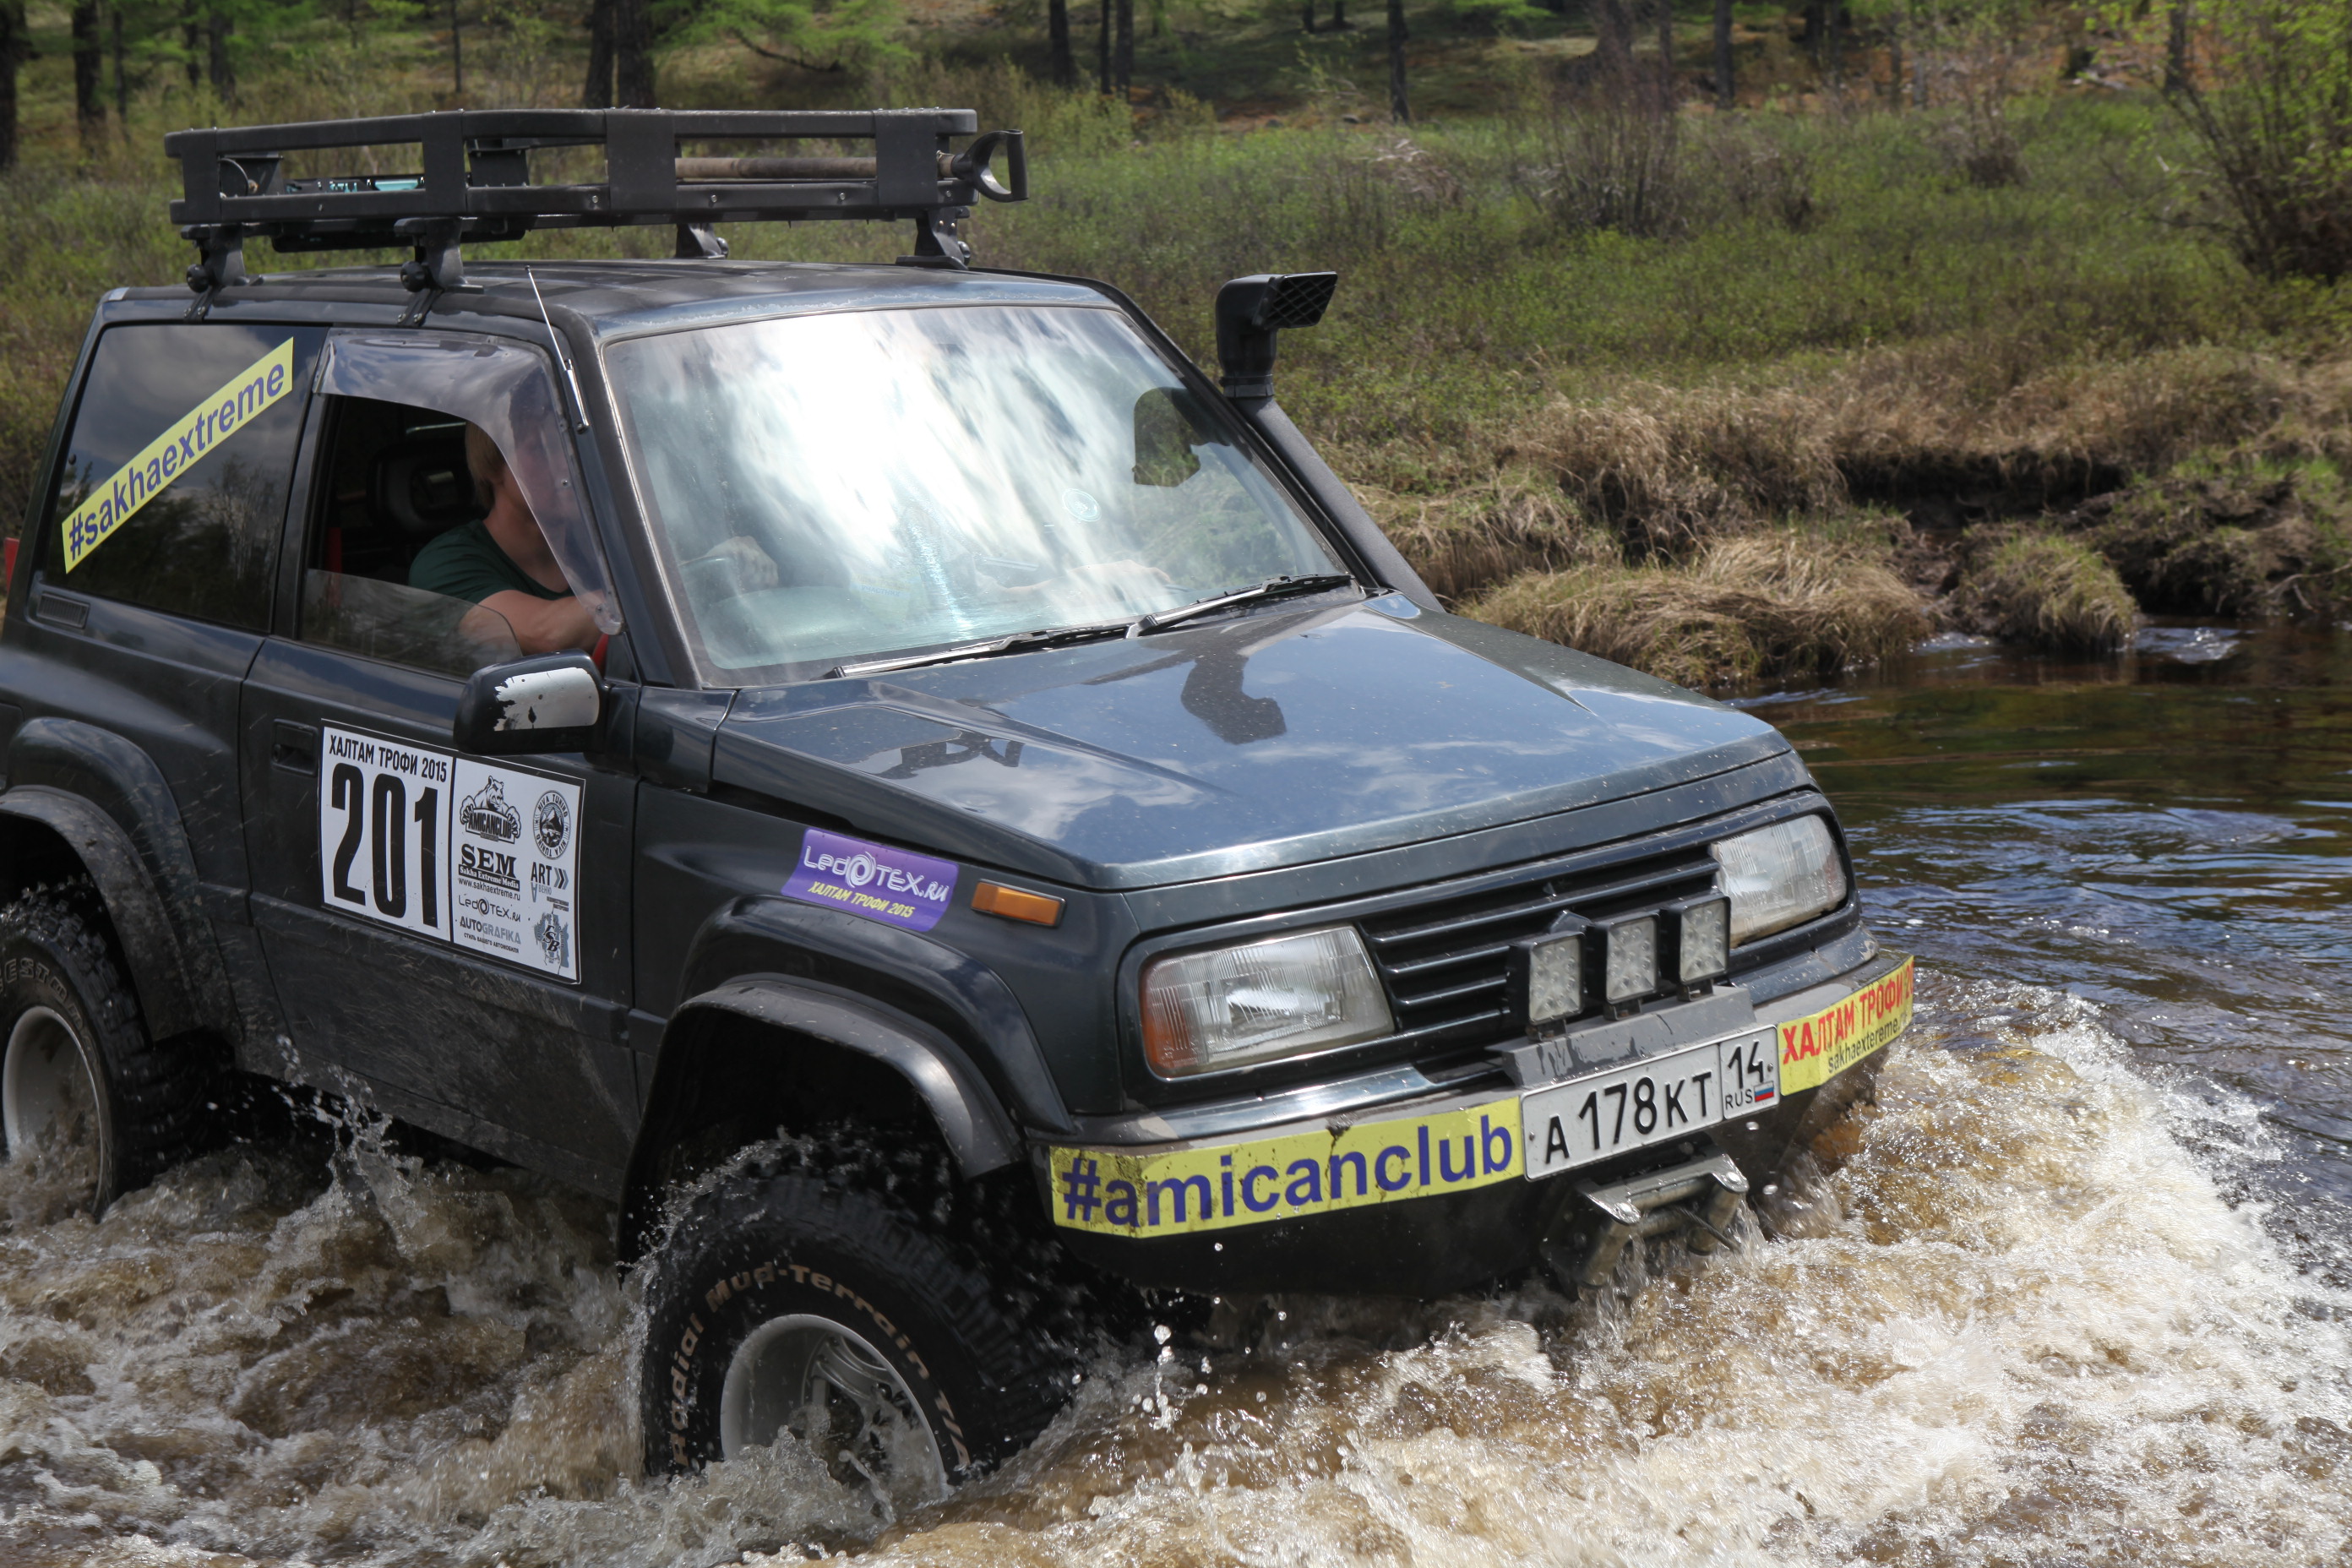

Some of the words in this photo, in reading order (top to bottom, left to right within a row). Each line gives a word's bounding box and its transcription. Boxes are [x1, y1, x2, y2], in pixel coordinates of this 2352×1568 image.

[69, 363, 285, 561] #sakhaextreme
[329, 734, 374, 765] ХАЛТАМ
[378, 746, 417, 776] ТРОФИ
[422, 757, 447, 782] 2015
[331, 762, 440, 929] 201
[461, 843, 517, 879] SEM
[458, 877, 520, 901] www.sakhaextreme.ru
[460, 866, 477, 878] Sakha
[477, 870, 502, 885] Extreme
[502, 878, 519, 888] Media
[531, 862, 552, 885] ART
[808, 881, 851, 901] ХАЛТАМ
[850, 892, 890, 912] ТРОФИ
[887, 902, 916, 918] 2015
[460, 916, 521, 945] AUTOGRAFIKA
[1783, 999, 1854, 1065] ХАЛТАМ
[1859, 972, 1903, 1029] ТРОФИ
[1728, 1041, 1765, 1091] 14
[1725, 1088, 1753, 1110] RUS
[1062, 1115, 1513, 1228] #amicanclub
[705, 1261, 930, 1380] Mud-Terrain
